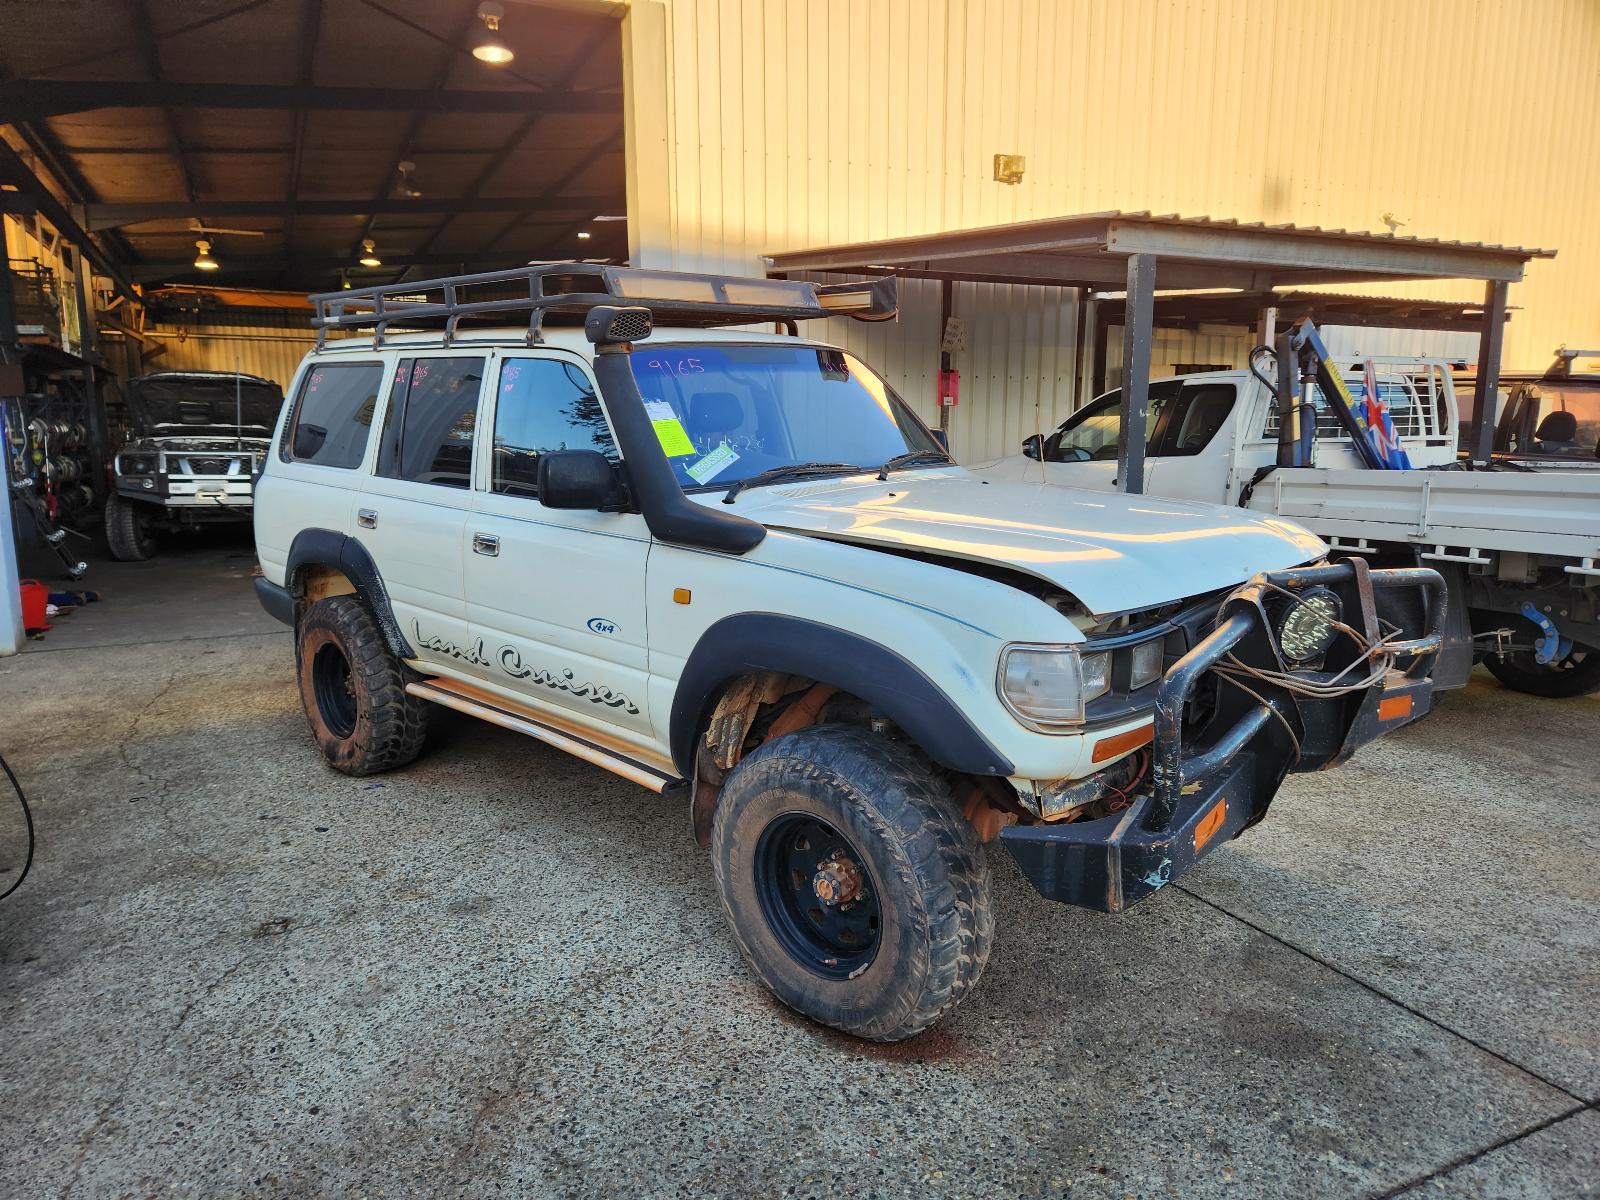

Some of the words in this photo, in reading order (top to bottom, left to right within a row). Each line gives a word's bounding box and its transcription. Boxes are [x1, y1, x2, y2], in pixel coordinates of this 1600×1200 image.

[648, 358, 705, 378] 9165
[595, 621, 615, 634] 4x4
[411, 616, 491, 667] Land
[496, 644, 640, 715] Cruiser
